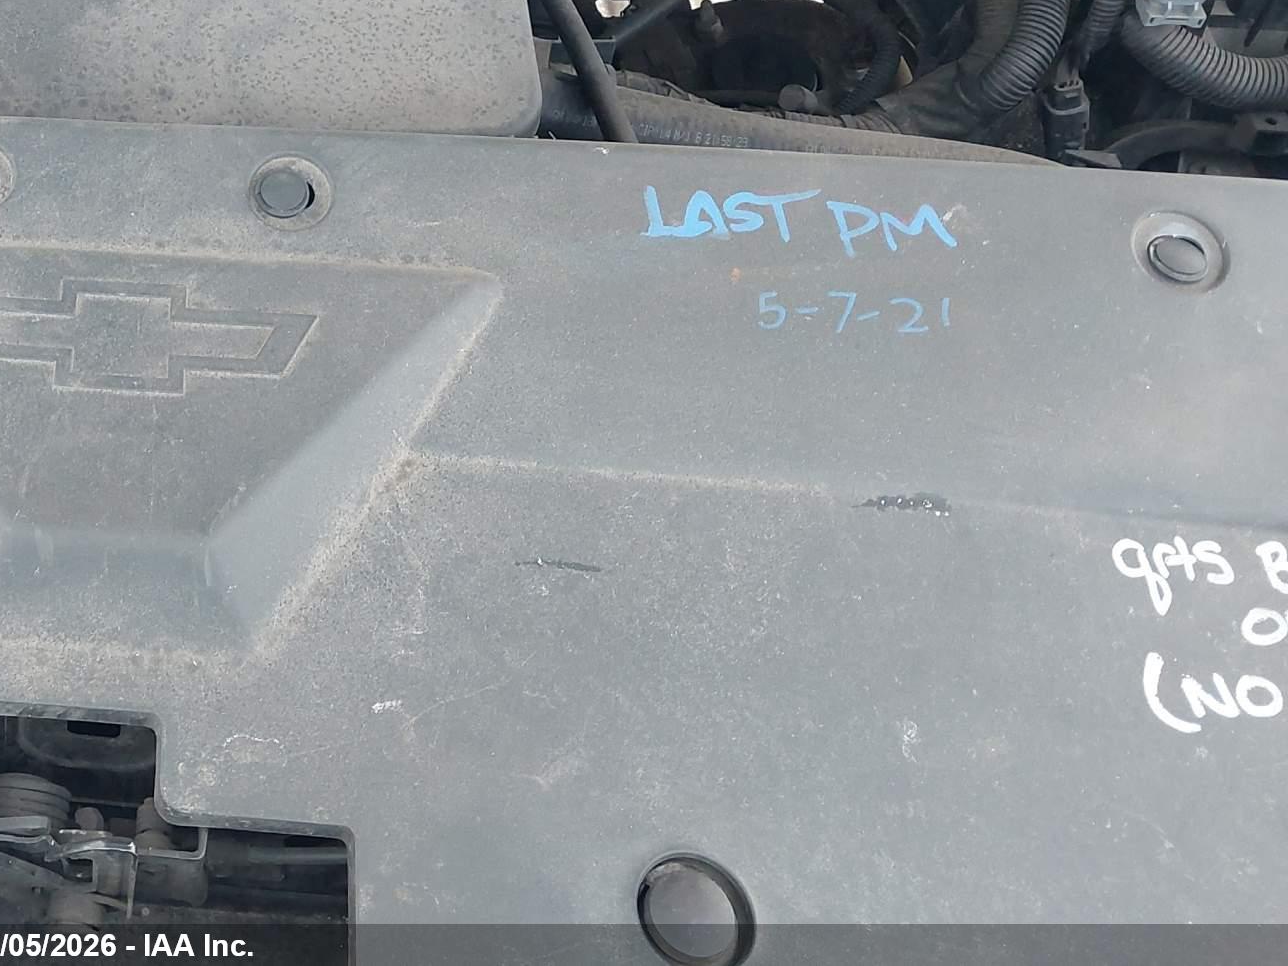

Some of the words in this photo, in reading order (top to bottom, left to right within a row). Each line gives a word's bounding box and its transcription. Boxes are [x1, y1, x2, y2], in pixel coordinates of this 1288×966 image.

[644, 186, 821, 242] LAST
[827, 200, 957, 256] PM
[758, 290, 949, 333] 5-7-21
